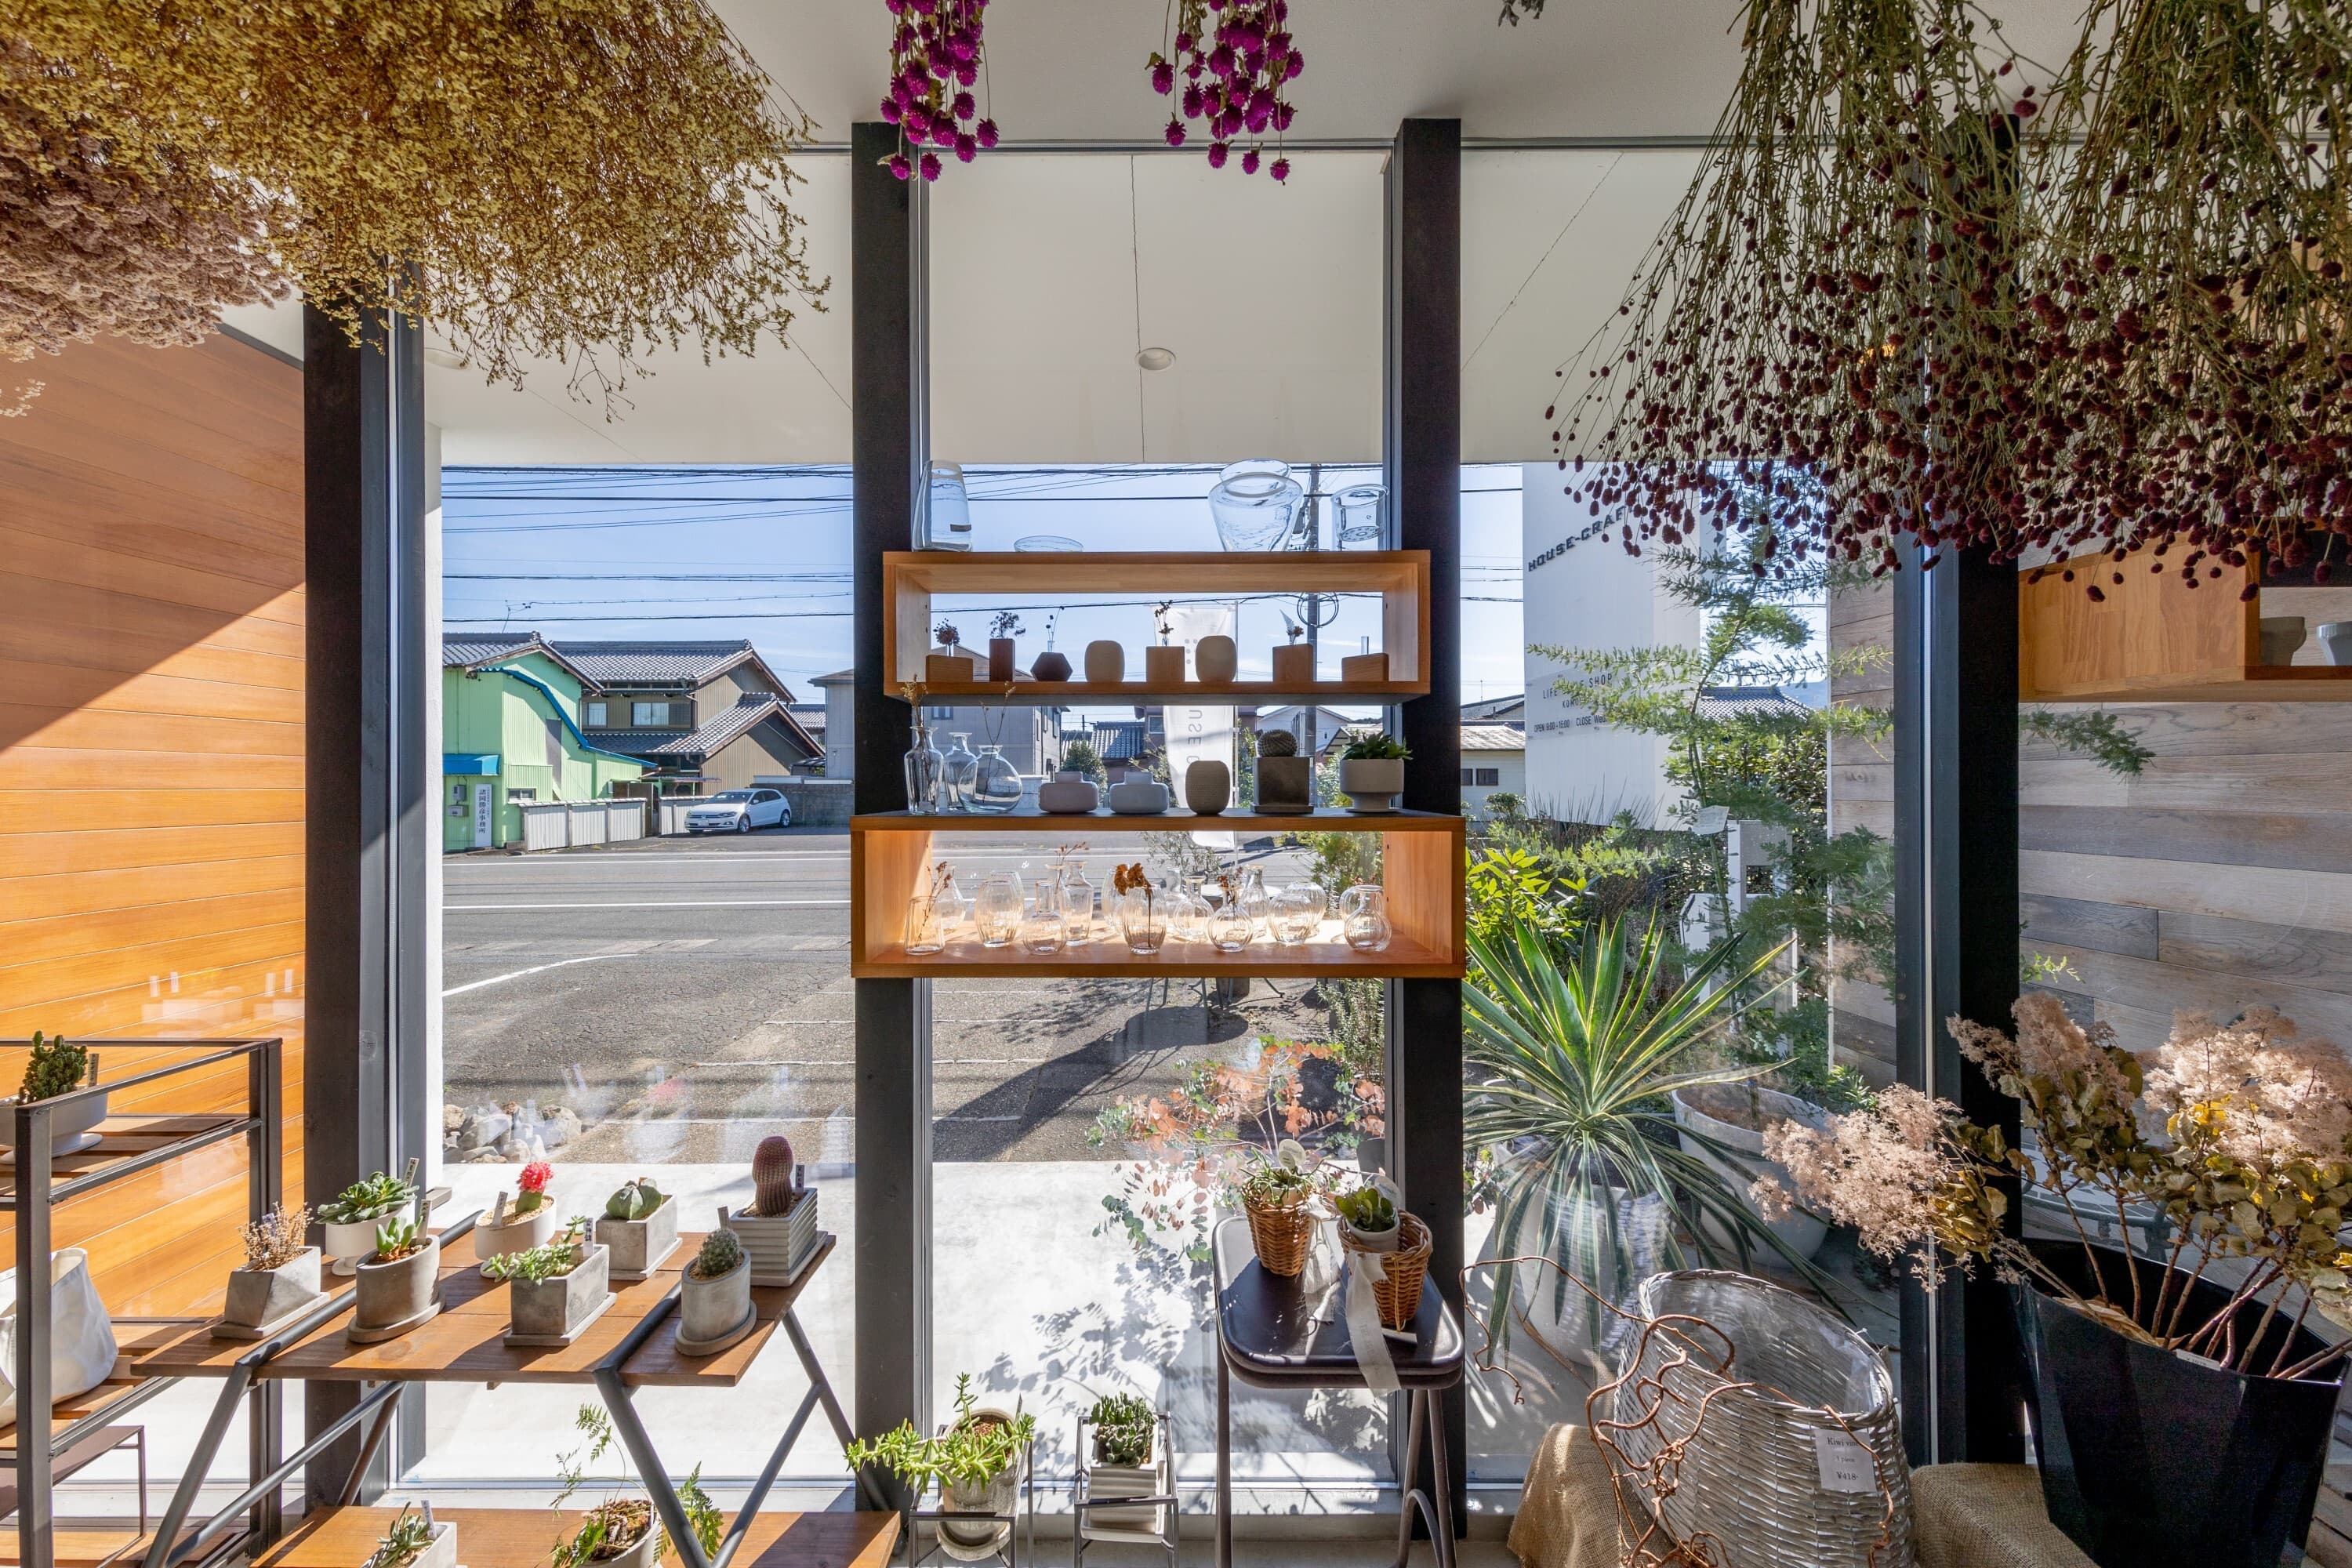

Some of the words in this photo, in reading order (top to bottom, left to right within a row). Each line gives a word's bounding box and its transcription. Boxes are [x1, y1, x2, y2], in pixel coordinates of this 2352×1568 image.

[1528, 506, 1632, 572] HOUSE-CRAF
[1589, 673, 1613, 688] SHOP
[1576, 716, 1592, 726] CLOSE
[1827, 1437, 1844, 1446] Kiwi
